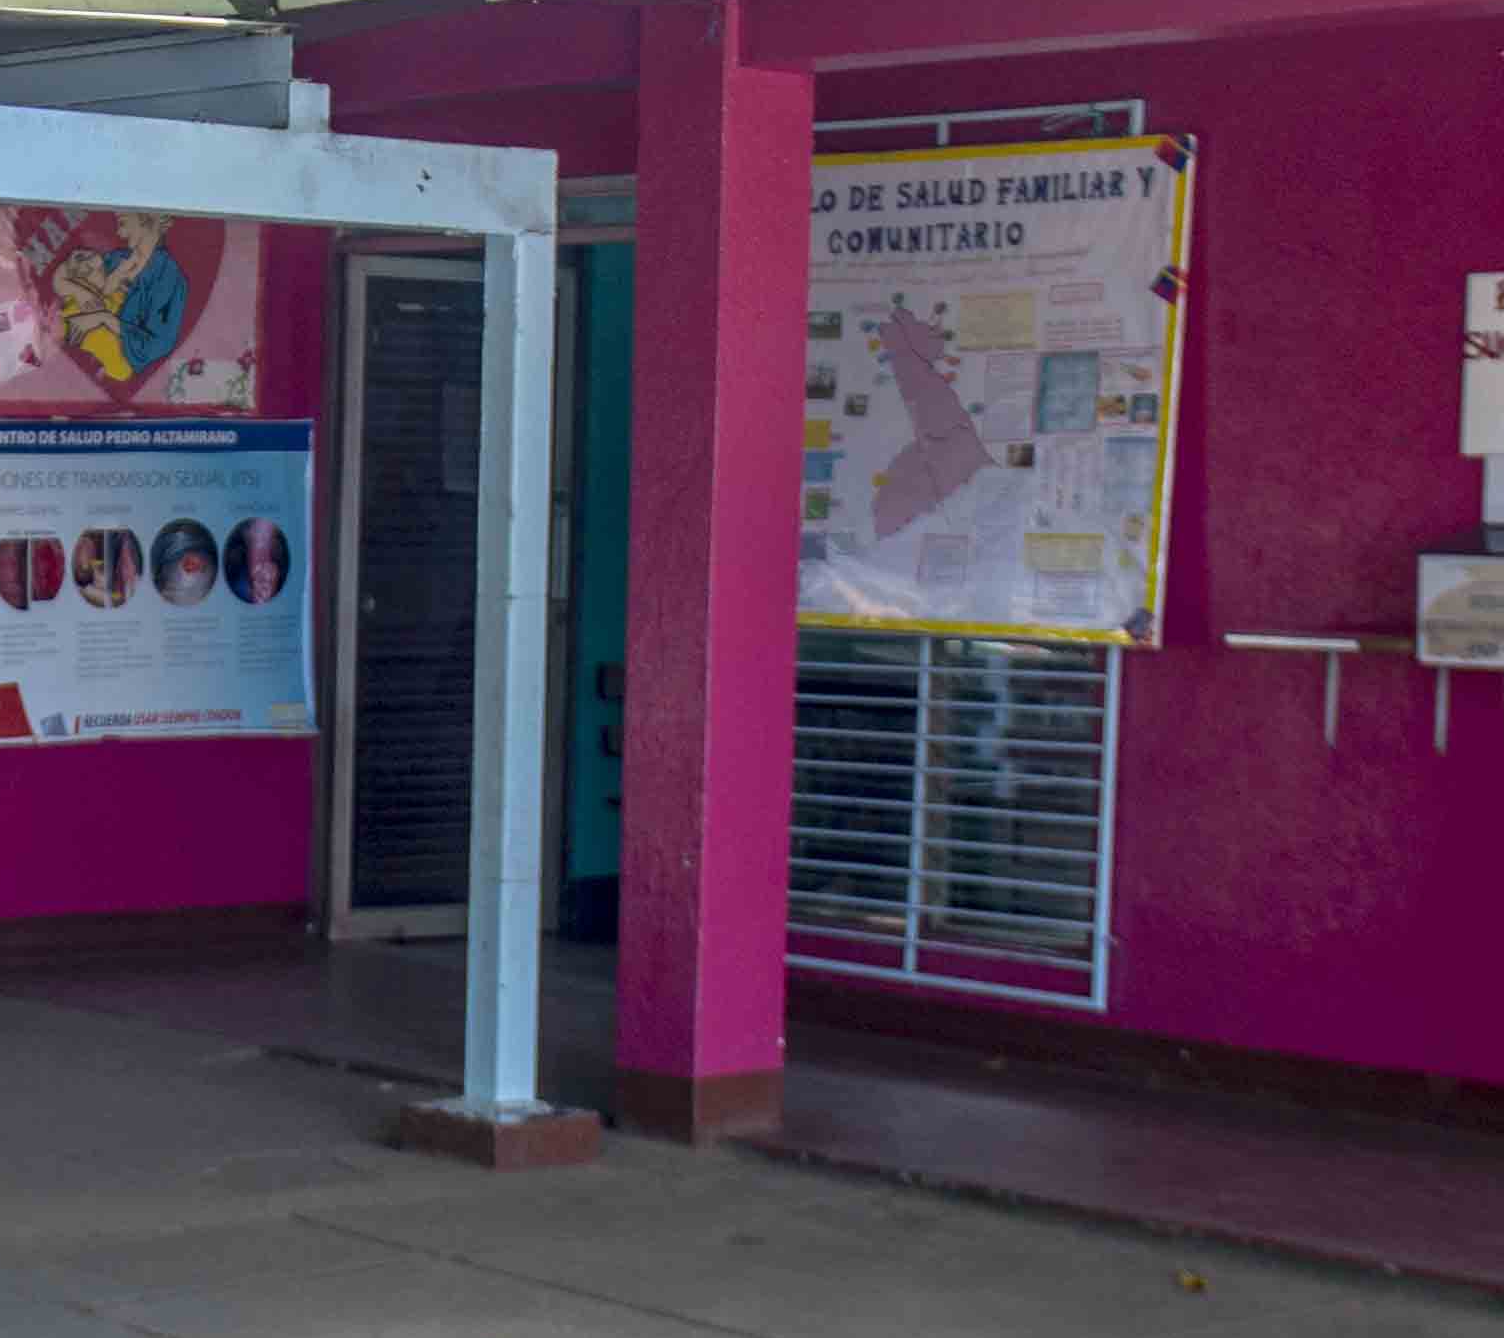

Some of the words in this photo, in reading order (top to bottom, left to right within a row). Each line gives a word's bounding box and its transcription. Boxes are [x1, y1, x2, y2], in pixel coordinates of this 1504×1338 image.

[849, 185, 884, 211] DE
[896, 179, 986, 210] SALUD
[995, 171, 1125, 206] FAMILIAR
[1136, 166, 1156, 199] Y
[828, 221, 1025, 255] COMUNITARIO
[41, 429, 58, 446] DE
[58, 429, 104, 446] SALUD
[105, 429, 152, 446] PEDRO
[152, 429, 239, 446] ALTAMIRANO
